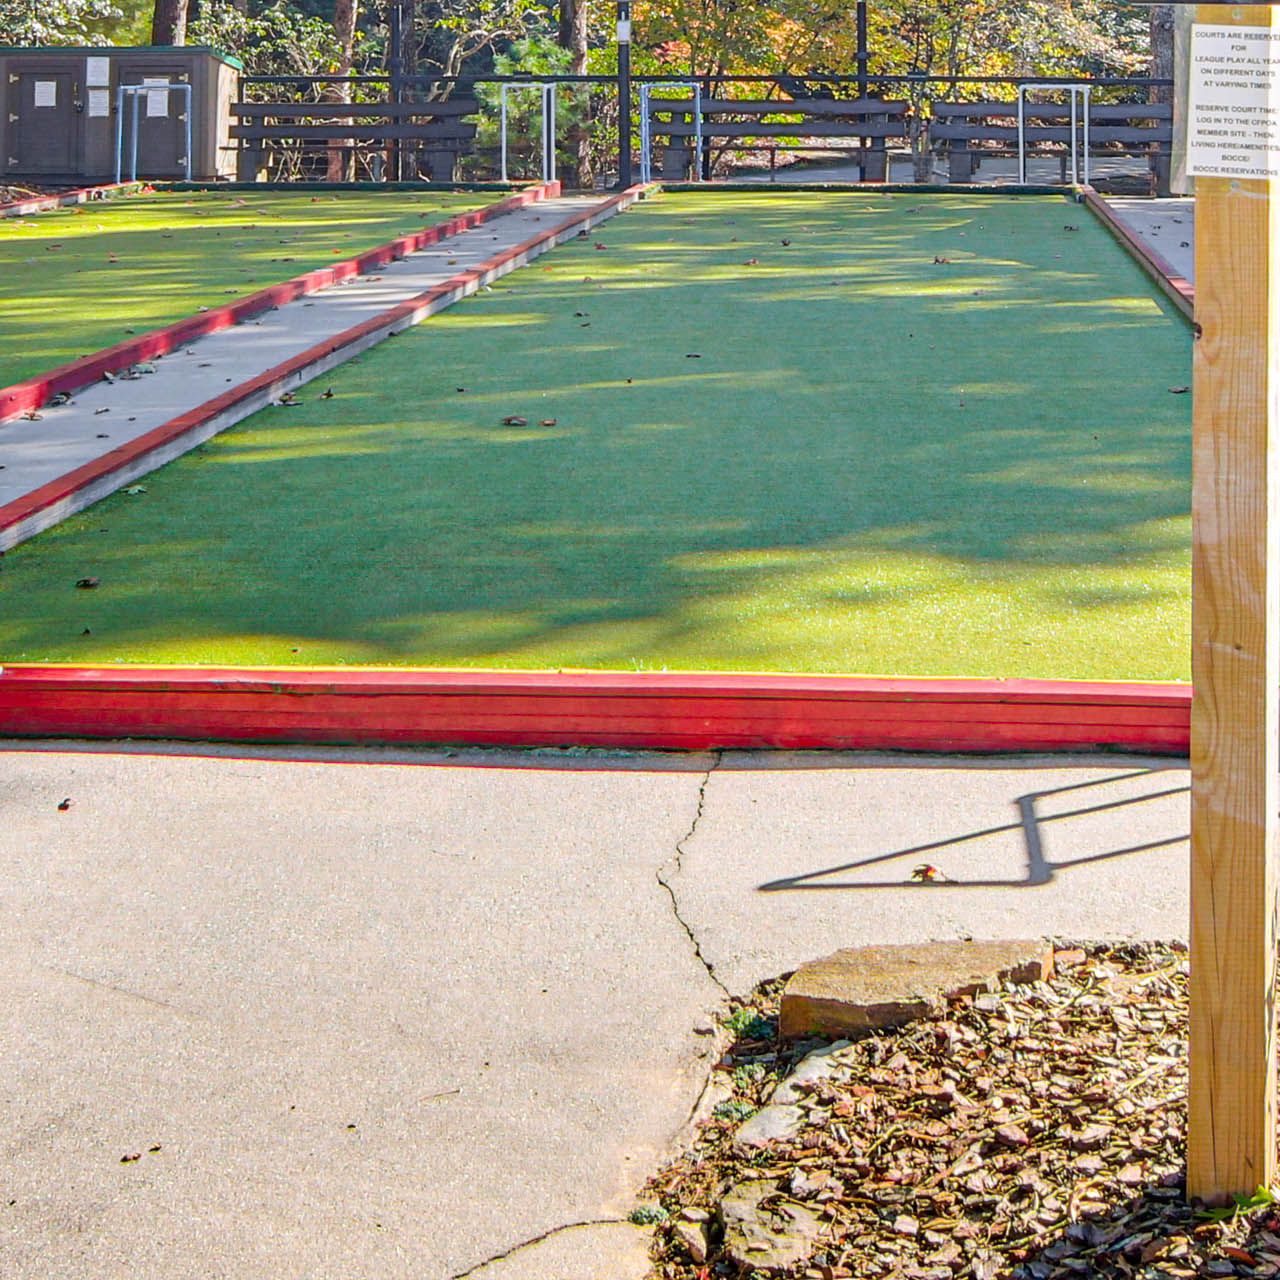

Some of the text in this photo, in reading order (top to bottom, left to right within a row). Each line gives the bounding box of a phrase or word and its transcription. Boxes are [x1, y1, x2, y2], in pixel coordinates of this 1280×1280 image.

[1195, 31, 1226, 39] COURTS
[1227, 31, 1242, 39] ARE
[1226, 56, 1245, 64] PLAY
[1213, 68, 1254, 76] DIFFERENT
[1195, 104, 1229, 112] RESERVE
[1193, 165, 1278, 176] BOCCE RESERVATIONS
